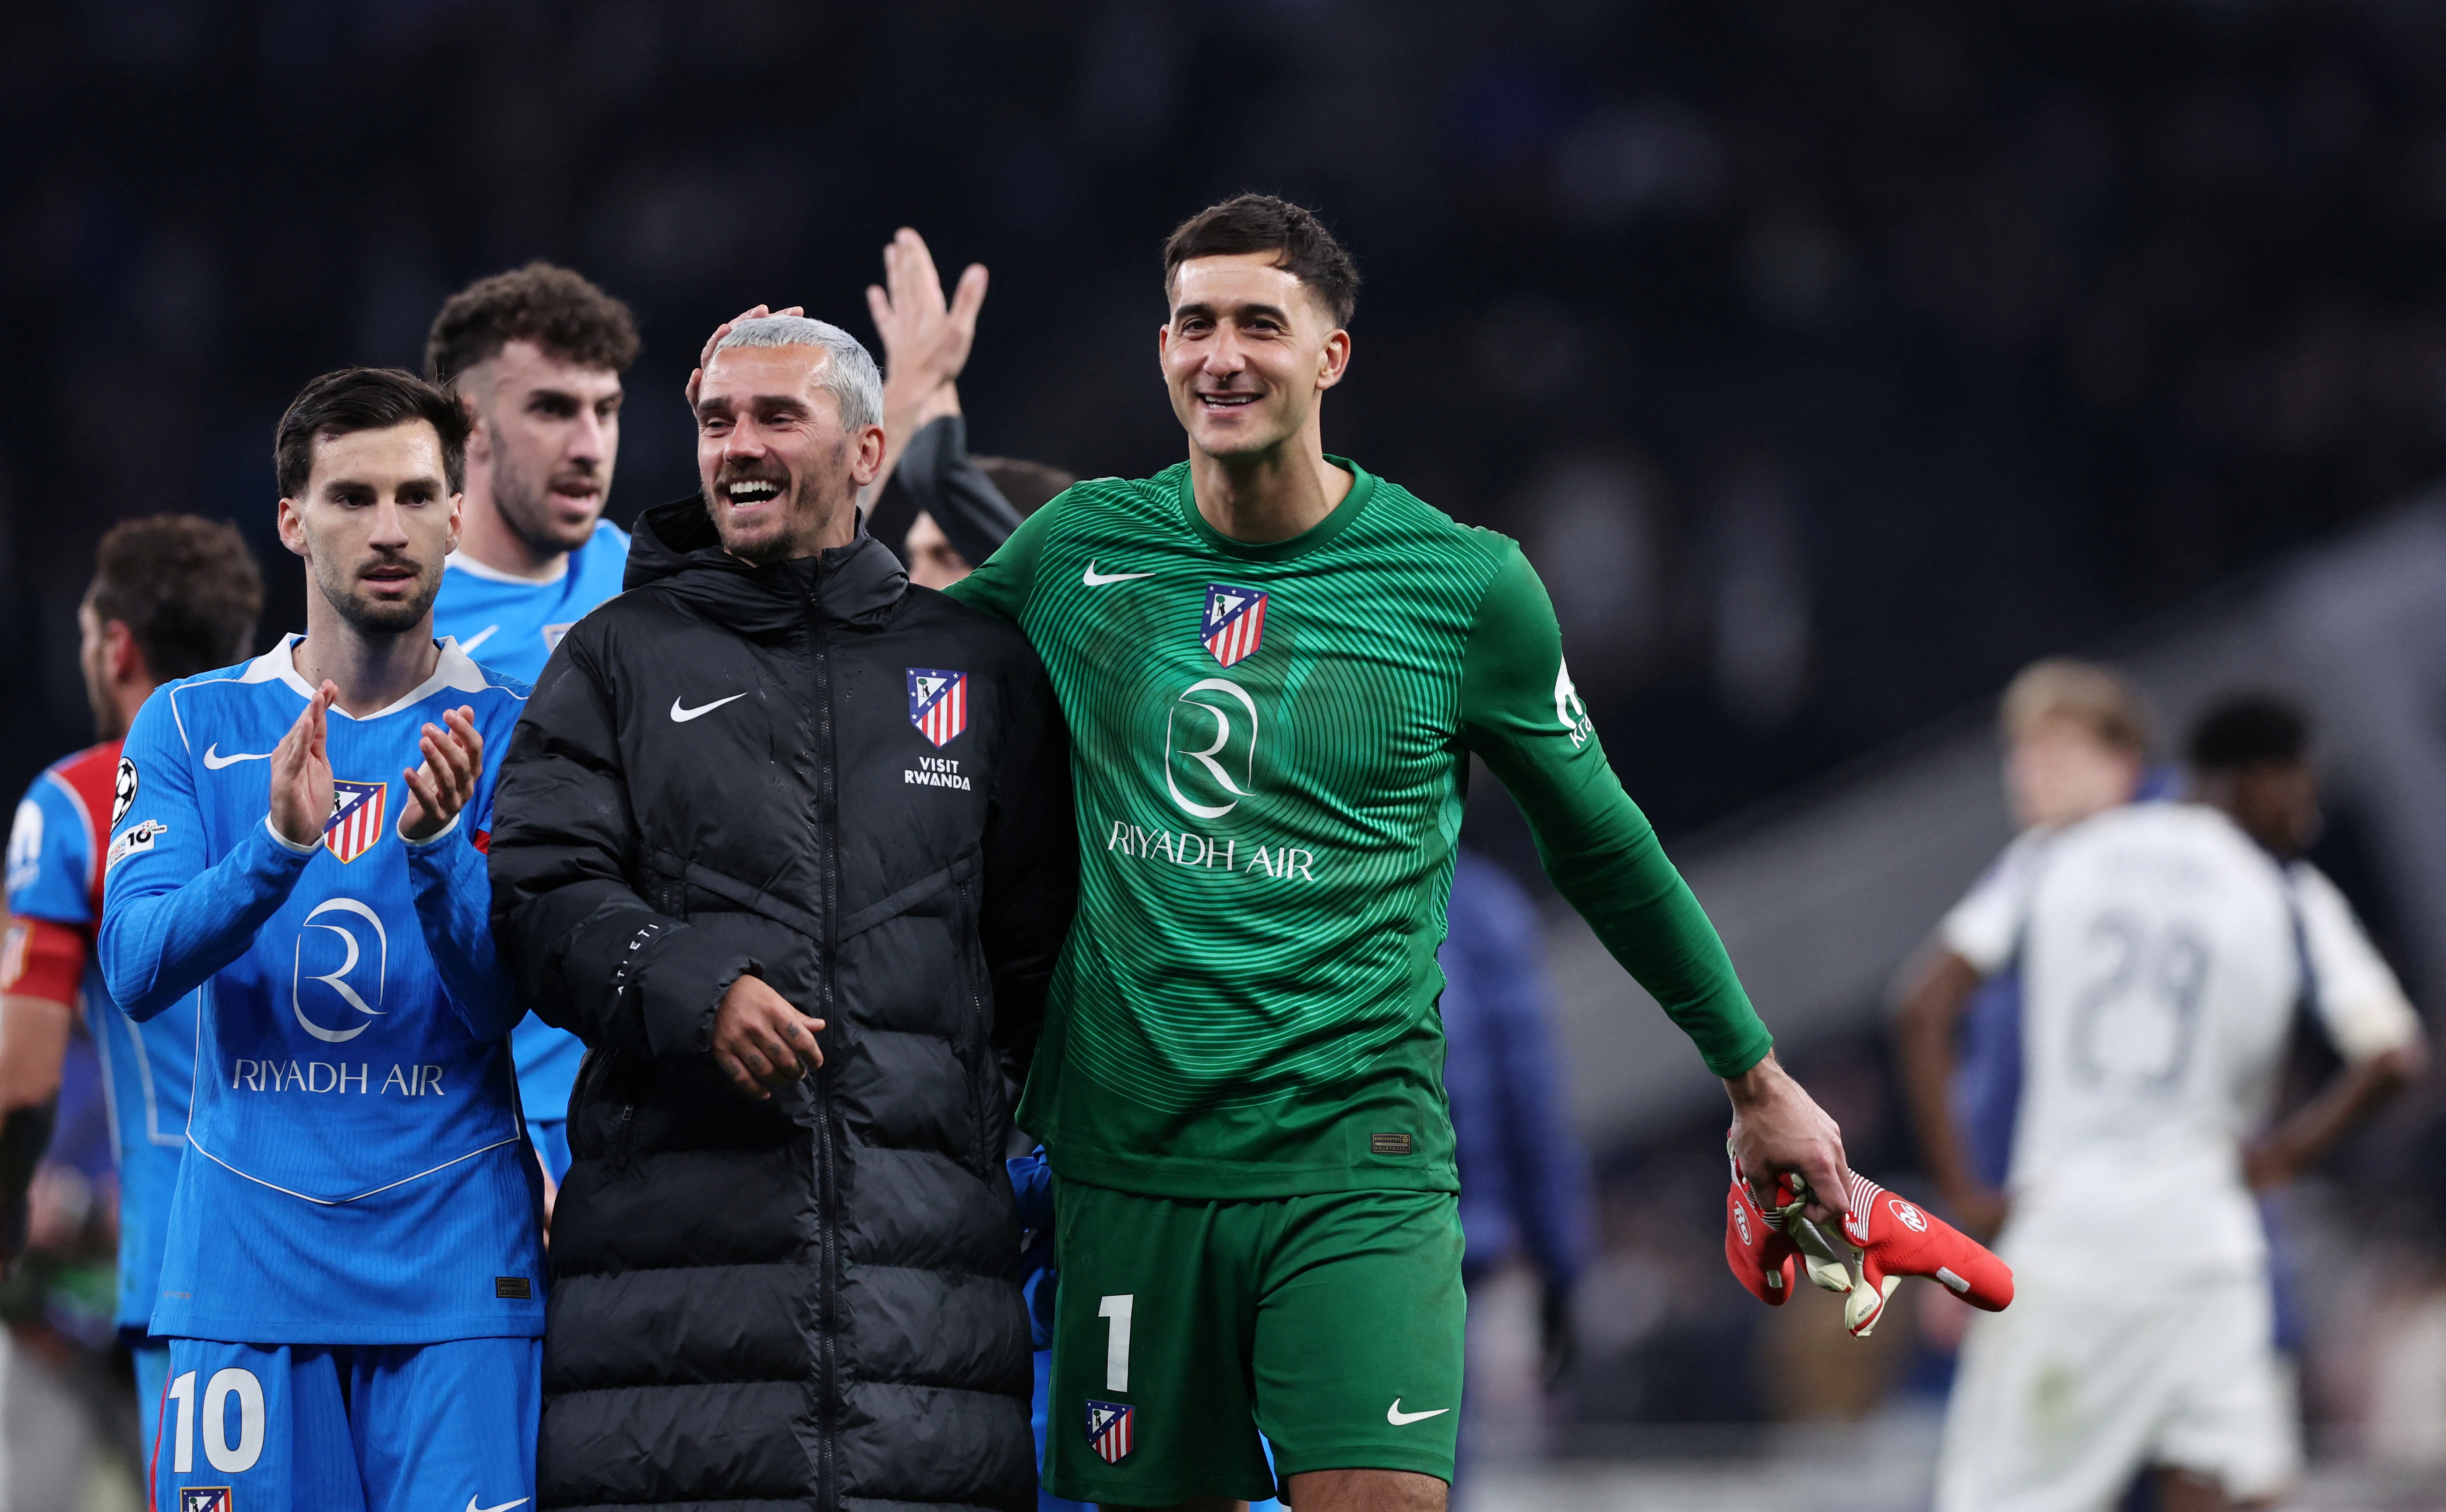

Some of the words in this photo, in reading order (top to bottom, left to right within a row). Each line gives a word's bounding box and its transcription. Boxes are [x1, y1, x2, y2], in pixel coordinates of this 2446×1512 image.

[919, 756, 959, 774] VISIT
[904, 770, 971, 791] RWANDA
[127, 830, 151, 846] 10
[1107, 820, 1234, 871] RIYADH
[1245, 845, 1314, 881] AIR
[233, 1059, 368, 1094] RIYADH
[381, 1064, 445, 1096] AIR
[1857, 1302, 1873, 1318] KRITON
[1098, 1294, 1134, 1393] 1
[168, 1367, 265, 1473] 10
